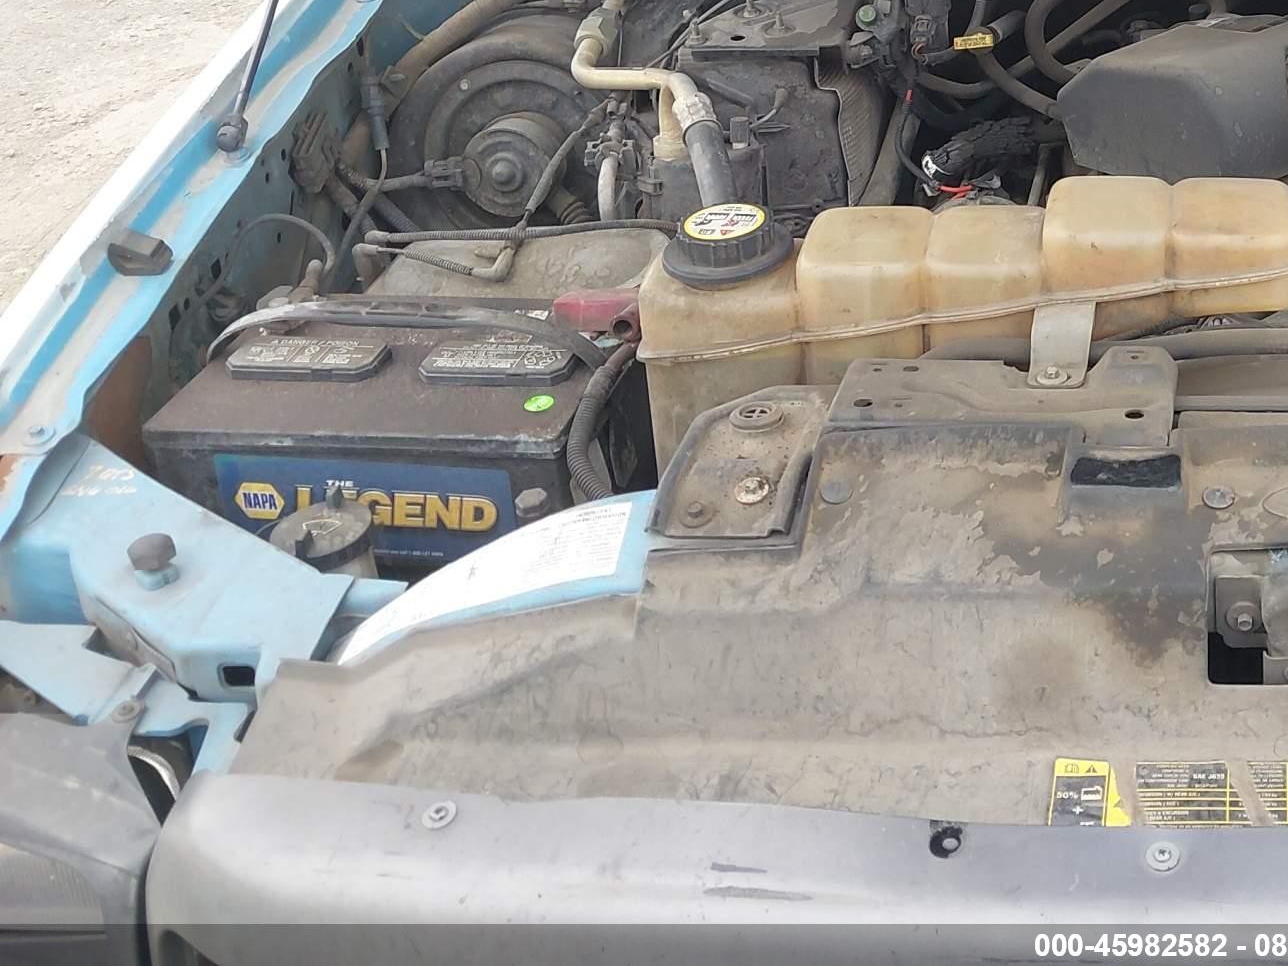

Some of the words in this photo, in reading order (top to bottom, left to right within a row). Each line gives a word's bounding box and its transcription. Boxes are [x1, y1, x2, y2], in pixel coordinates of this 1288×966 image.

[325, 479, 354, 488] THE
[242, 491, 279, 511] NAPA
[294, 484, 498, 532] GEND
